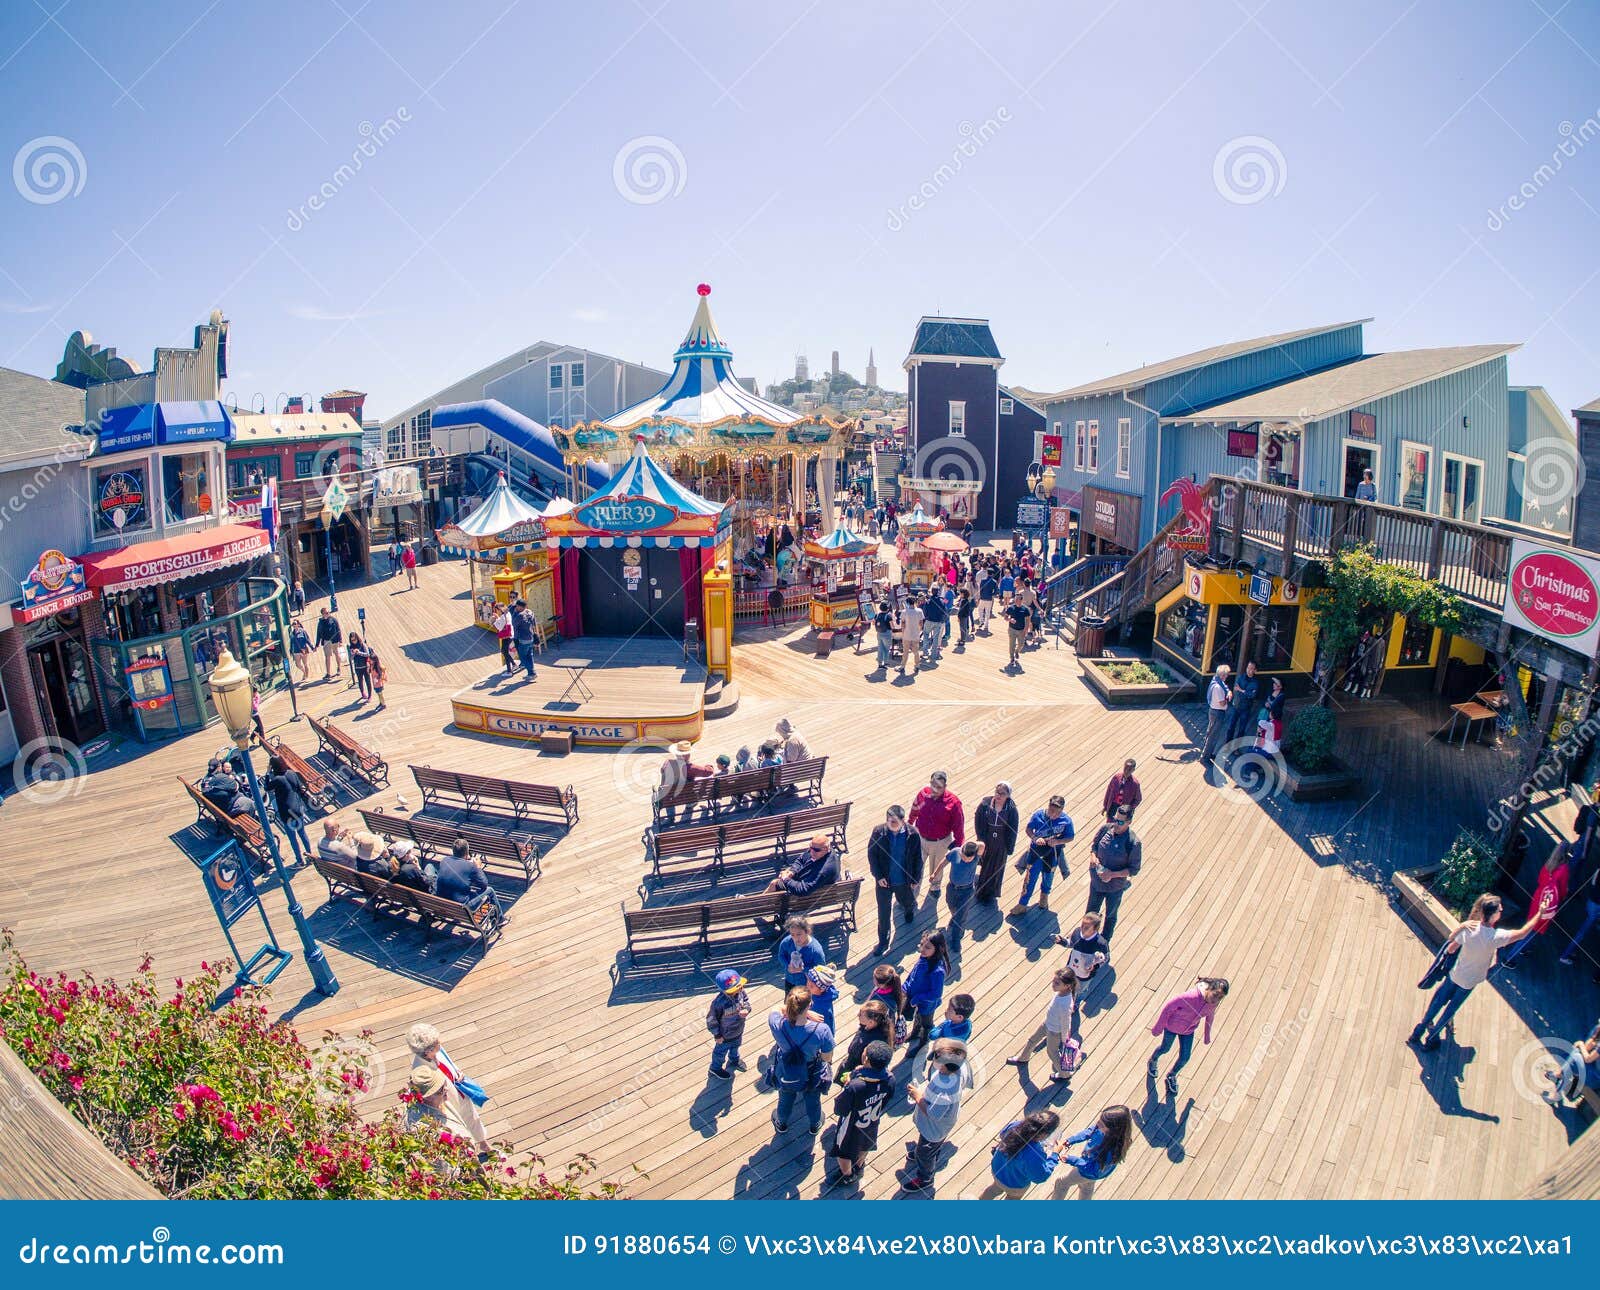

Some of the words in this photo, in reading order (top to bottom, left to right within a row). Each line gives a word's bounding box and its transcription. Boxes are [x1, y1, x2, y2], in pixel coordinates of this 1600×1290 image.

[595, 506, 634, 521] PIER
[634, 505, 656, 523] 39
[1095, 500, 1115, 516] STUDIO
[124, 549, 213, 580] SPORTSGRILL
[223, 536, 262, 558] ARCADE
[1521, 565, 1590, 603] Christmas
[31, 602, 58, 619] LUNCH
[63, 590, 94, 607] DINNER
[1534, 596, 1552, 611] San
[1552, 602, 1592, 626] Francisco
[567, 725, 625, 738] STAGE
[855, 1099, 883, 1128] 30
